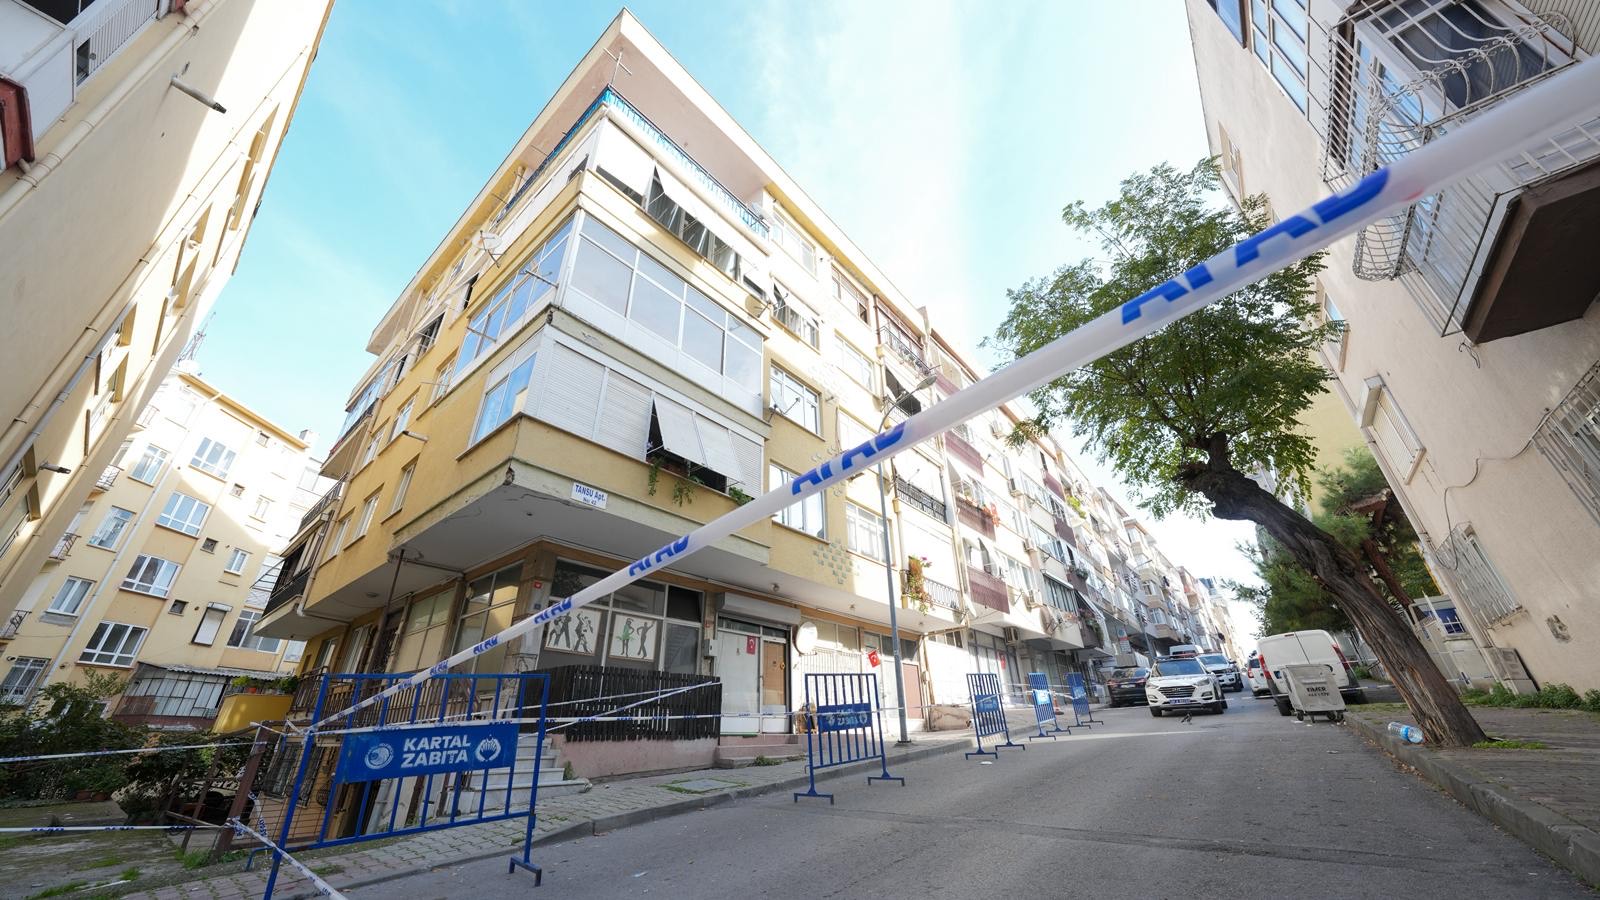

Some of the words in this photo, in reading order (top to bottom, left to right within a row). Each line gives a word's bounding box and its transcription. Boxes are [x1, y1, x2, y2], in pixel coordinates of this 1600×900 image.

[575, 484, 594, 498] TANSU
[594, 491, 606, 502] Apt.
[403, 734, 471, 752] KARTAL
[401, 748, 469, 769] ZABITA
